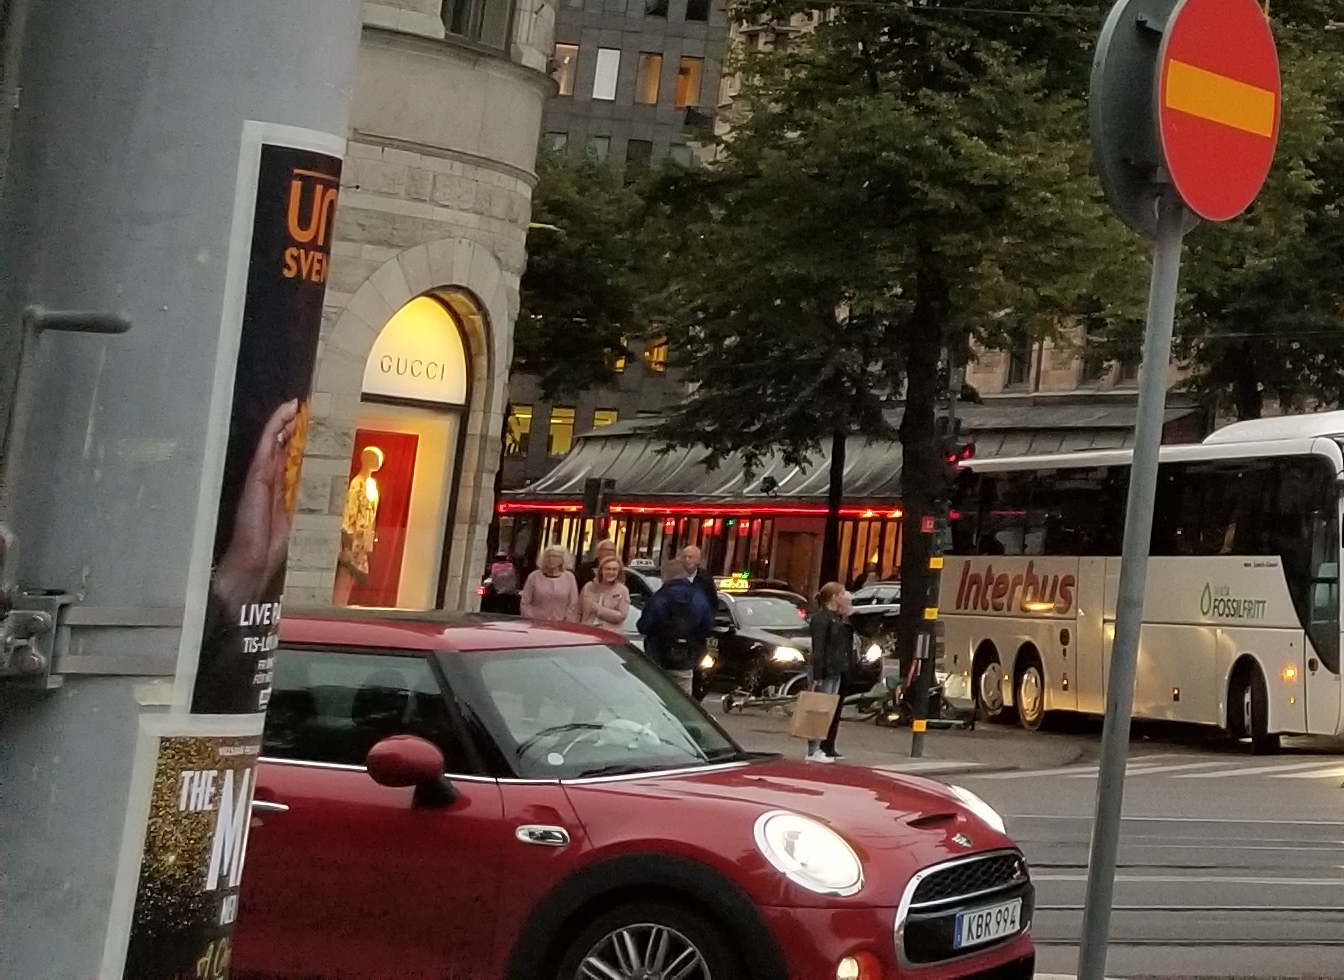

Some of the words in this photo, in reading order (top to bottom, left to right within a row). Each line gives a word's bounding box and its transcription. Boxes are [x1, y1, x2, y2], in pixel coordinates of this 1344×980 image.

[380, 354, 445, 381] GUCCI
[956, 559, 1075, 615] Interbus
[240, 603, 272, 627] LIVE
[179, 770, 217, 810] THE
[966, 911, 993, 942] KBR
[995, 904, 1018, 936] 994
